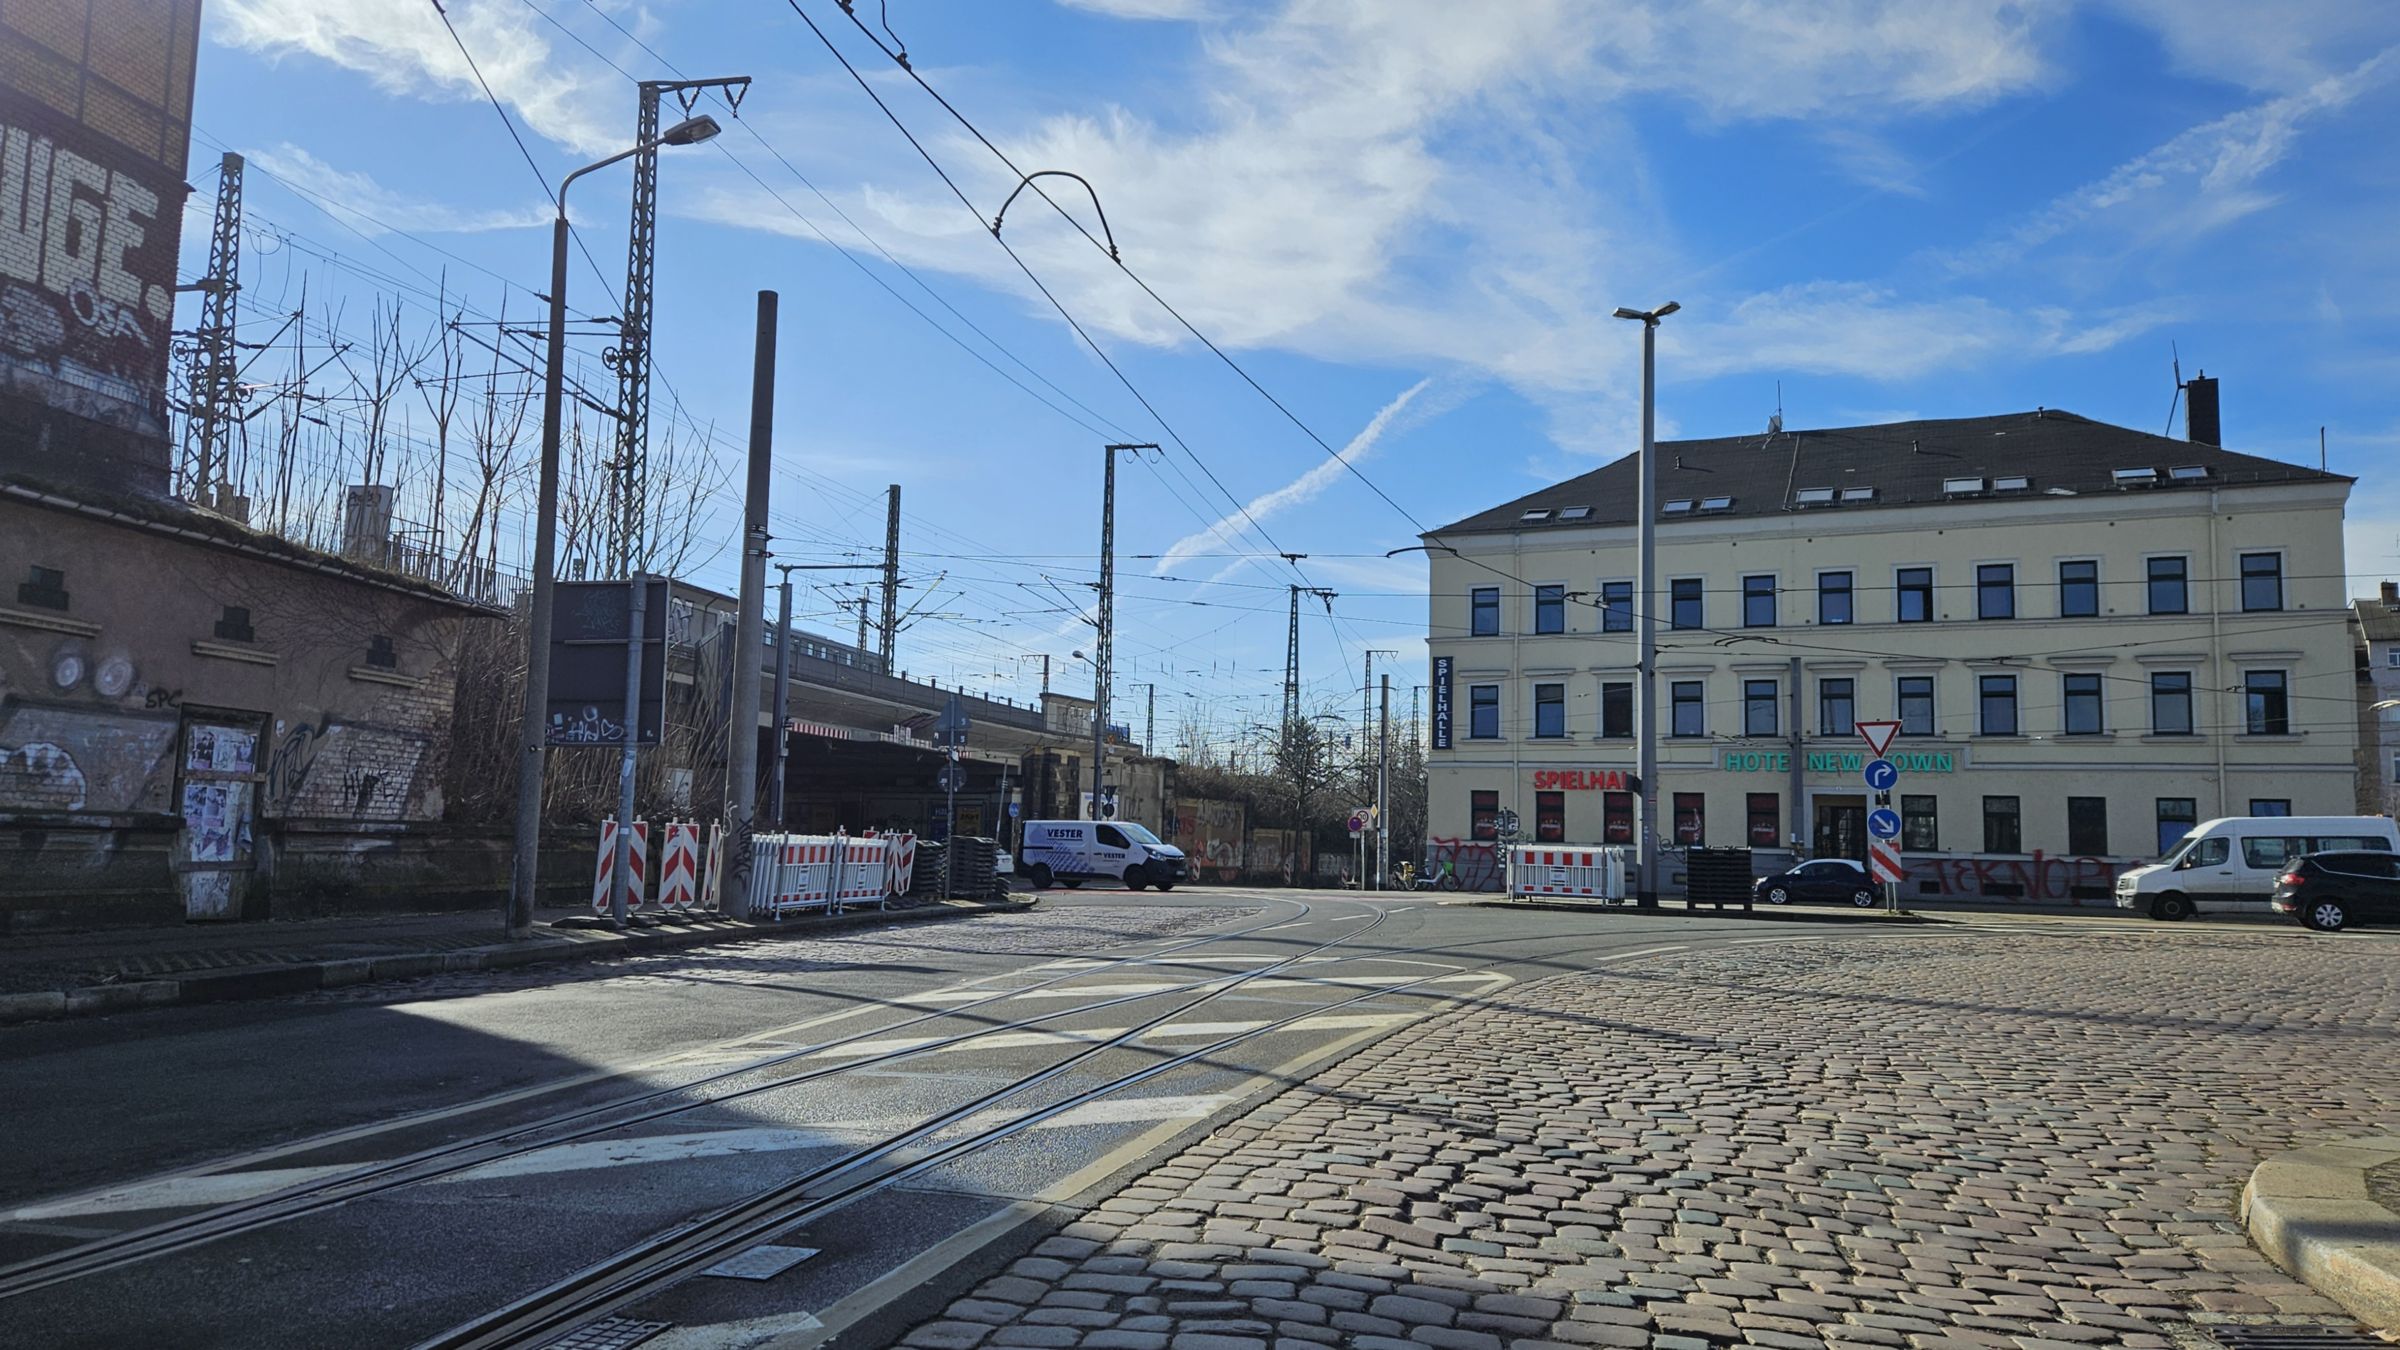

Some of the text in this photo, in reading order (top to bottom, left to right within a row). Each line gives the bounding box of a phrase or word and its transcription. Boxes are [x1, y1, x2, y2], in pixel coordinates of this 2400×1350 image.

[1437, 659, 1448, 747] SPIELHALLE
[1725, 752, 1953, 773] HOTE NEW OWN
[1046, 828, 1083, 839] VESTER
